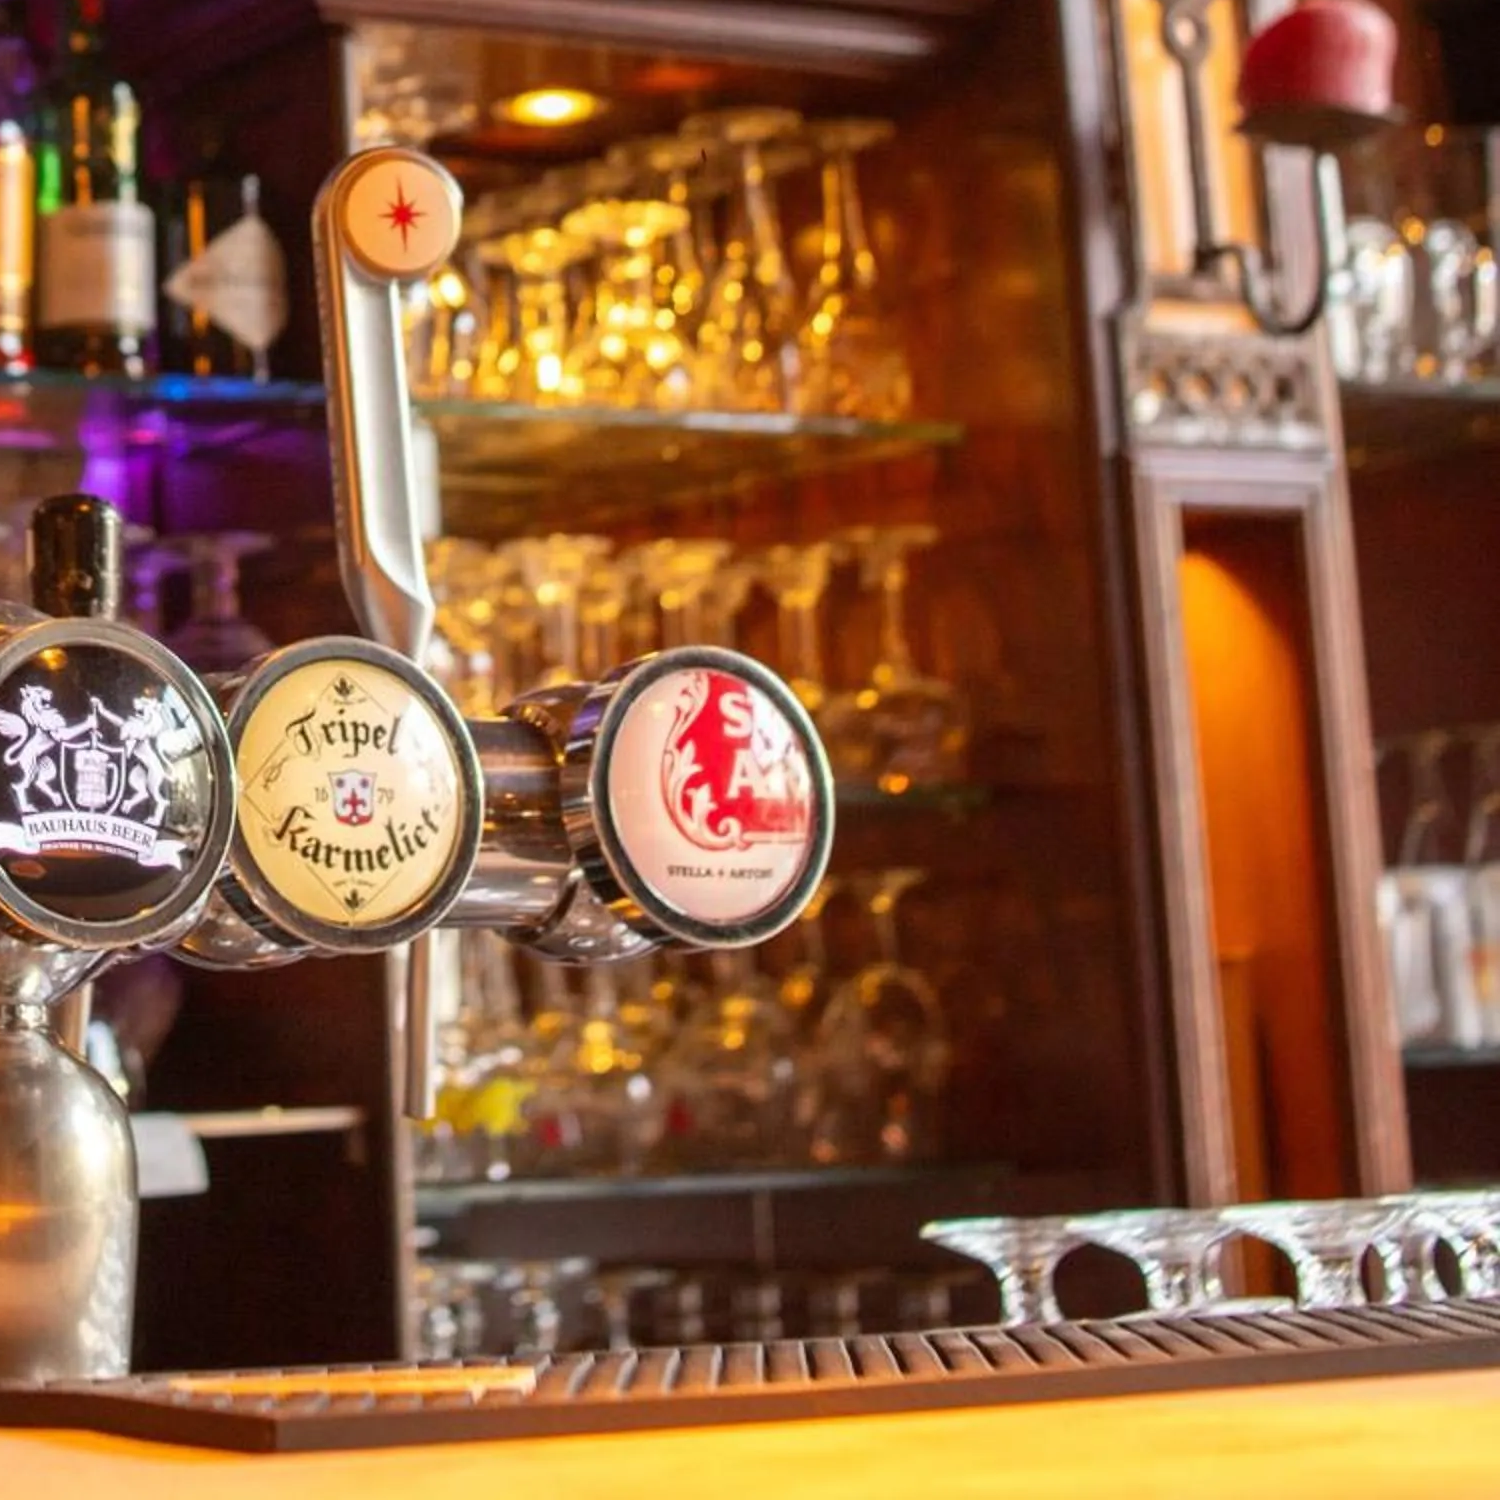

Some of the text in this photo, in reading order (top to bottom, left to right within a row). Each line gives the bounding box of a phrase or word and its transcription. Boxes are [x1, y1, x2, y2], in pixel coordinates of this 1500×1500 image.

[284, 706, 402, 760] Tripel
[27, 818, 154, 848] BAUHAUS BEER
[666, 864, 715, 879] STELLA
